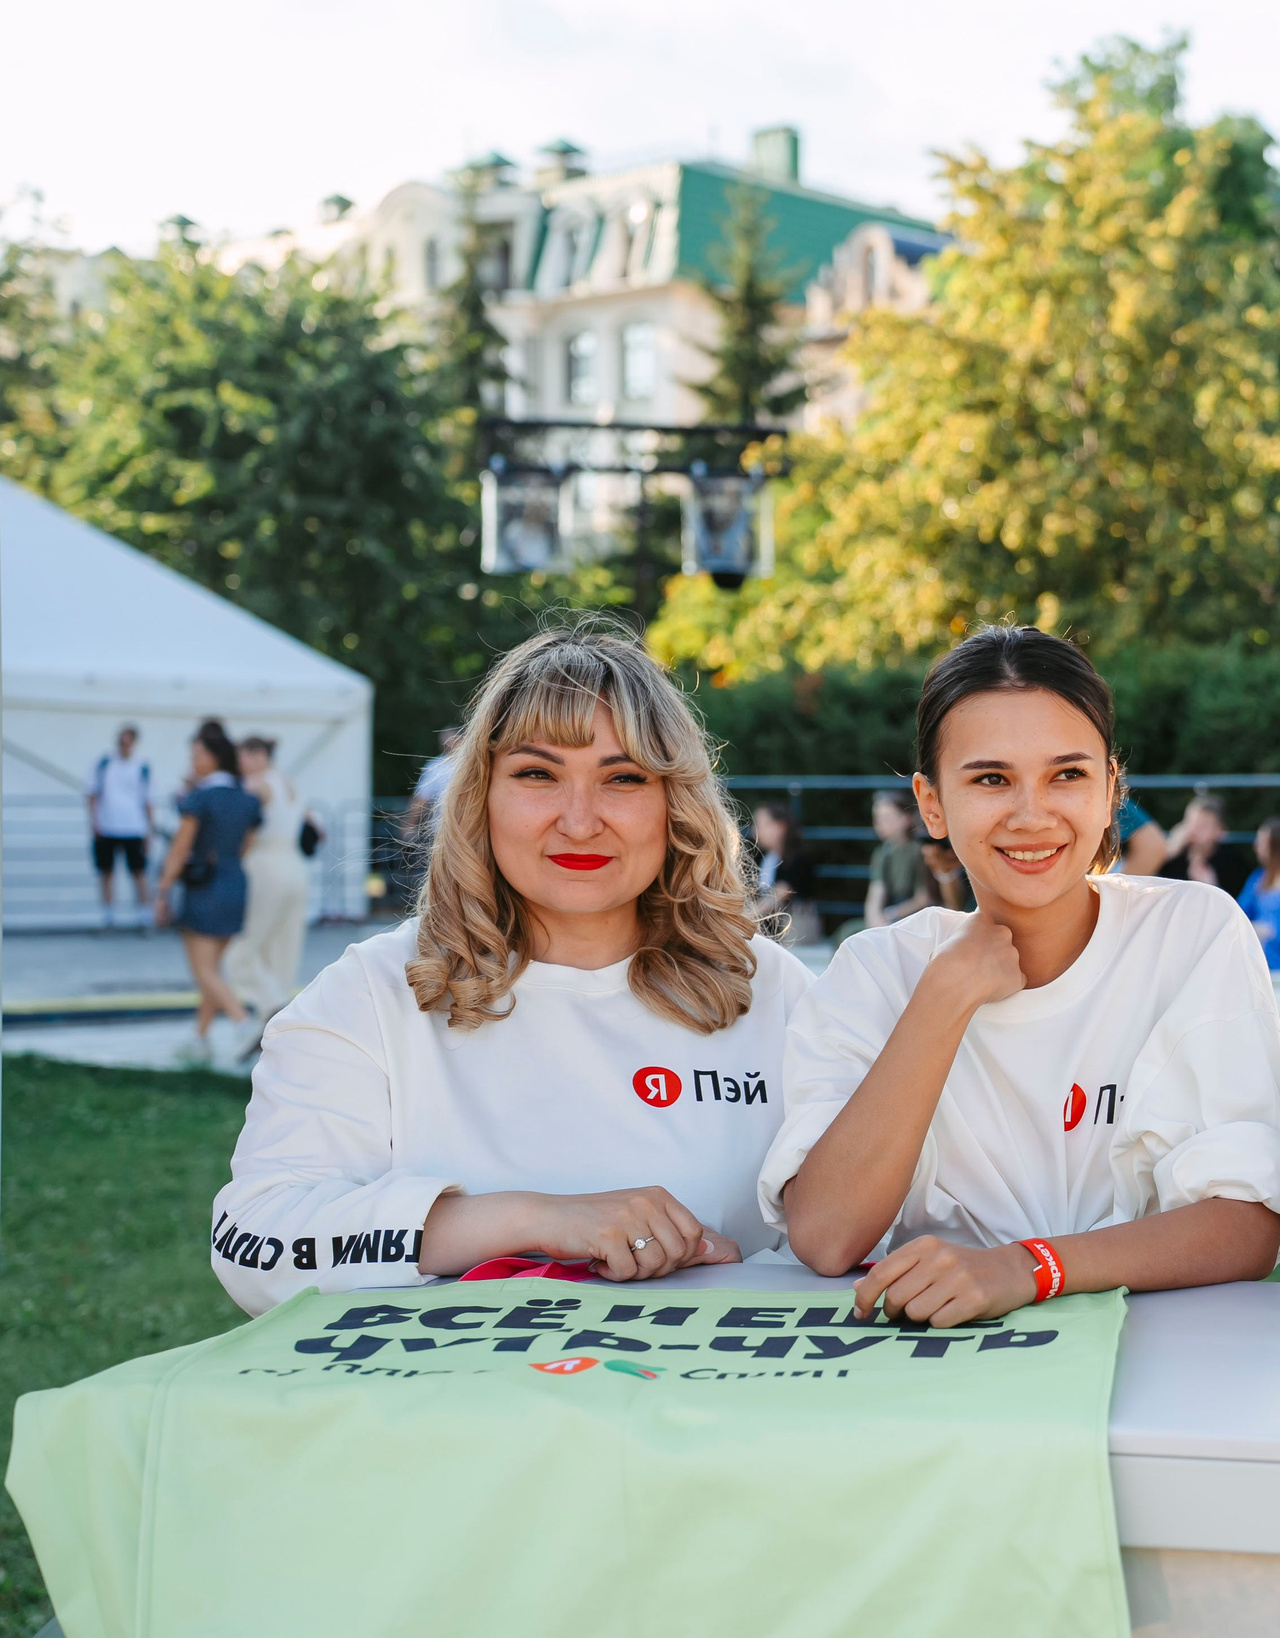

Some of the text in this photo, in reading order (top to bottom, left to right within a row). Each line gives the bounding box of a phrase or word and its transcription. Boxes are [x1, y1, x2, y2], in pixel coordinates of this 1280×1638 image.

[693, 1069, 768, 1105] Пэй
[292, 1237, 318, 1270] В
[1033, 1243, 1061, 1299] Маркет
[323, 1299, 1004, 1333] ВСЁ И ЕЩ
[294, 1328, 1060, 1362] ЧУТЬ-ЧУТЬ
